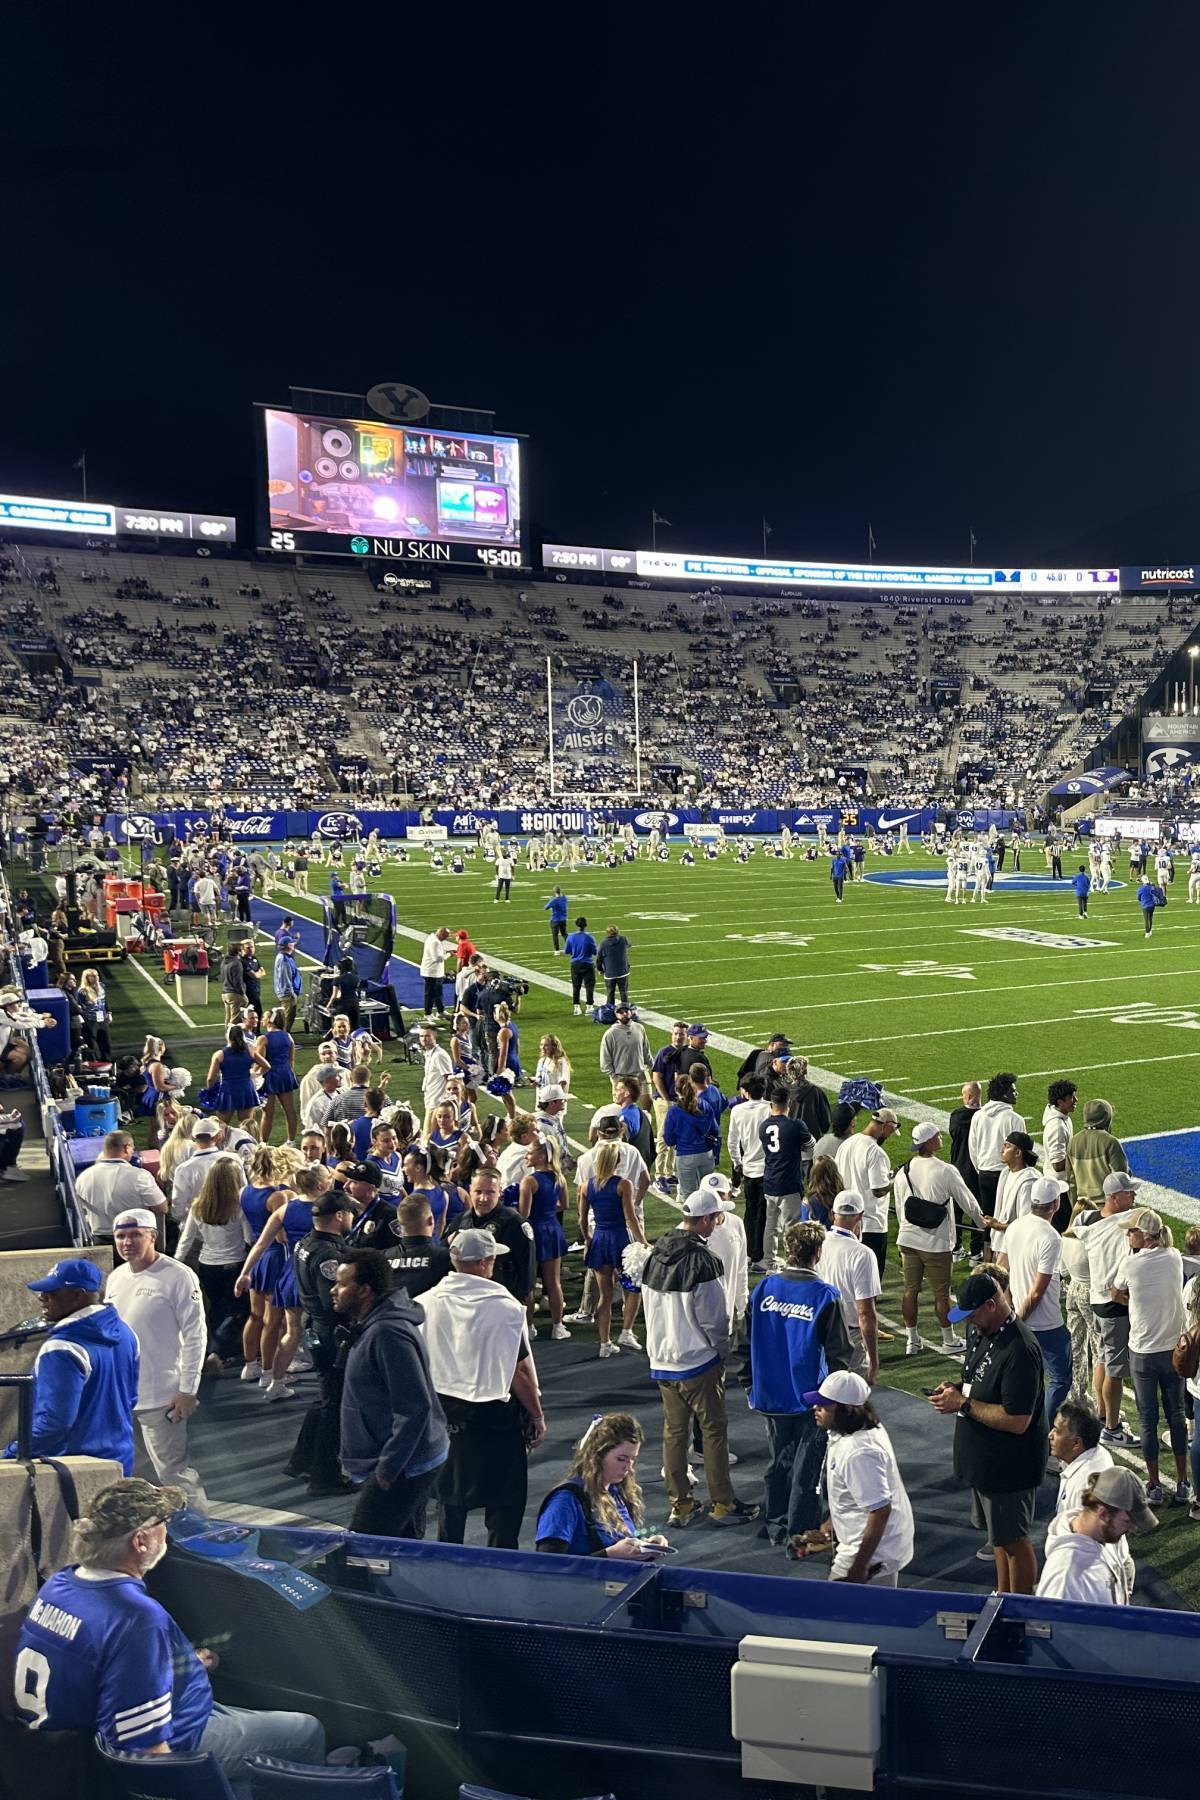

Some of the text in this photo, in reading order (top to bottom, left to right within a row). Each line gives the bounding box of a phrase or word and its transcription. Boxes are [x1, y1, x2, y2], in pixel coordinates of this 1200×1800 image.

[377, 386, 419, 416] Y
[270, 532, 522, 567] 25 45:00
[374, 539, 450, 561] NU SKIN
[579, 554, 597, 566] PM
[1141, 568, 1194, 580] nutricost
[902, 595, 942, 604] Riverside
[520, 812, 600, 832] #GOCOUS
[718, 812, 757, 827] SHIPEX
[842, 814, 857, 825] 25
[1158, 860, 1167, 869] 10
[857, 960, 974, 977] 20
[1072, 1001, 1200, 1025] 10
[765, 1124, 780, 1153] 3
[760, 1294, 814, 1322] Cougars
[28, 1597, 83, 1641] McMAHON
[14, 1646, 51, 1730] 9
